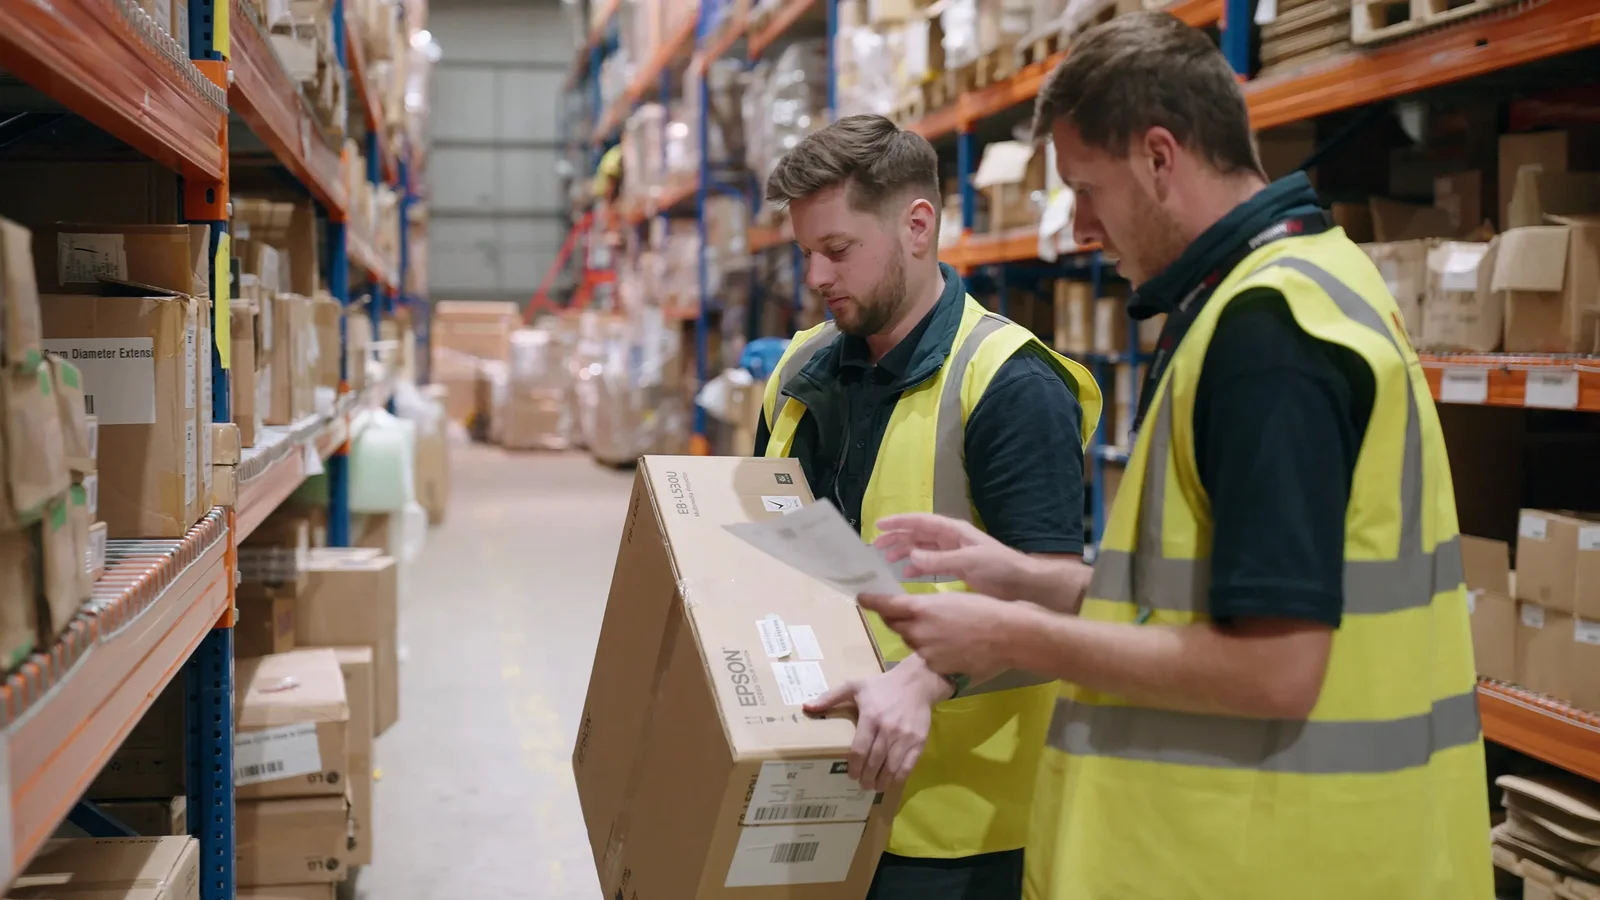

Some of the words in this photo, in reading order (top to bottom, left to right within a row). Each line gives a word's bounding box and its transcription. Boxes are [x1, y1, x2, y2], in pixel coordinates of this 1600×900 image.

[72, 348, 116, 359] Diameter
[119, 347, 154, 358] Extensi
[665, 471, 689, 514] EB-L530U
[723, 650, 758, 707] EPSON
